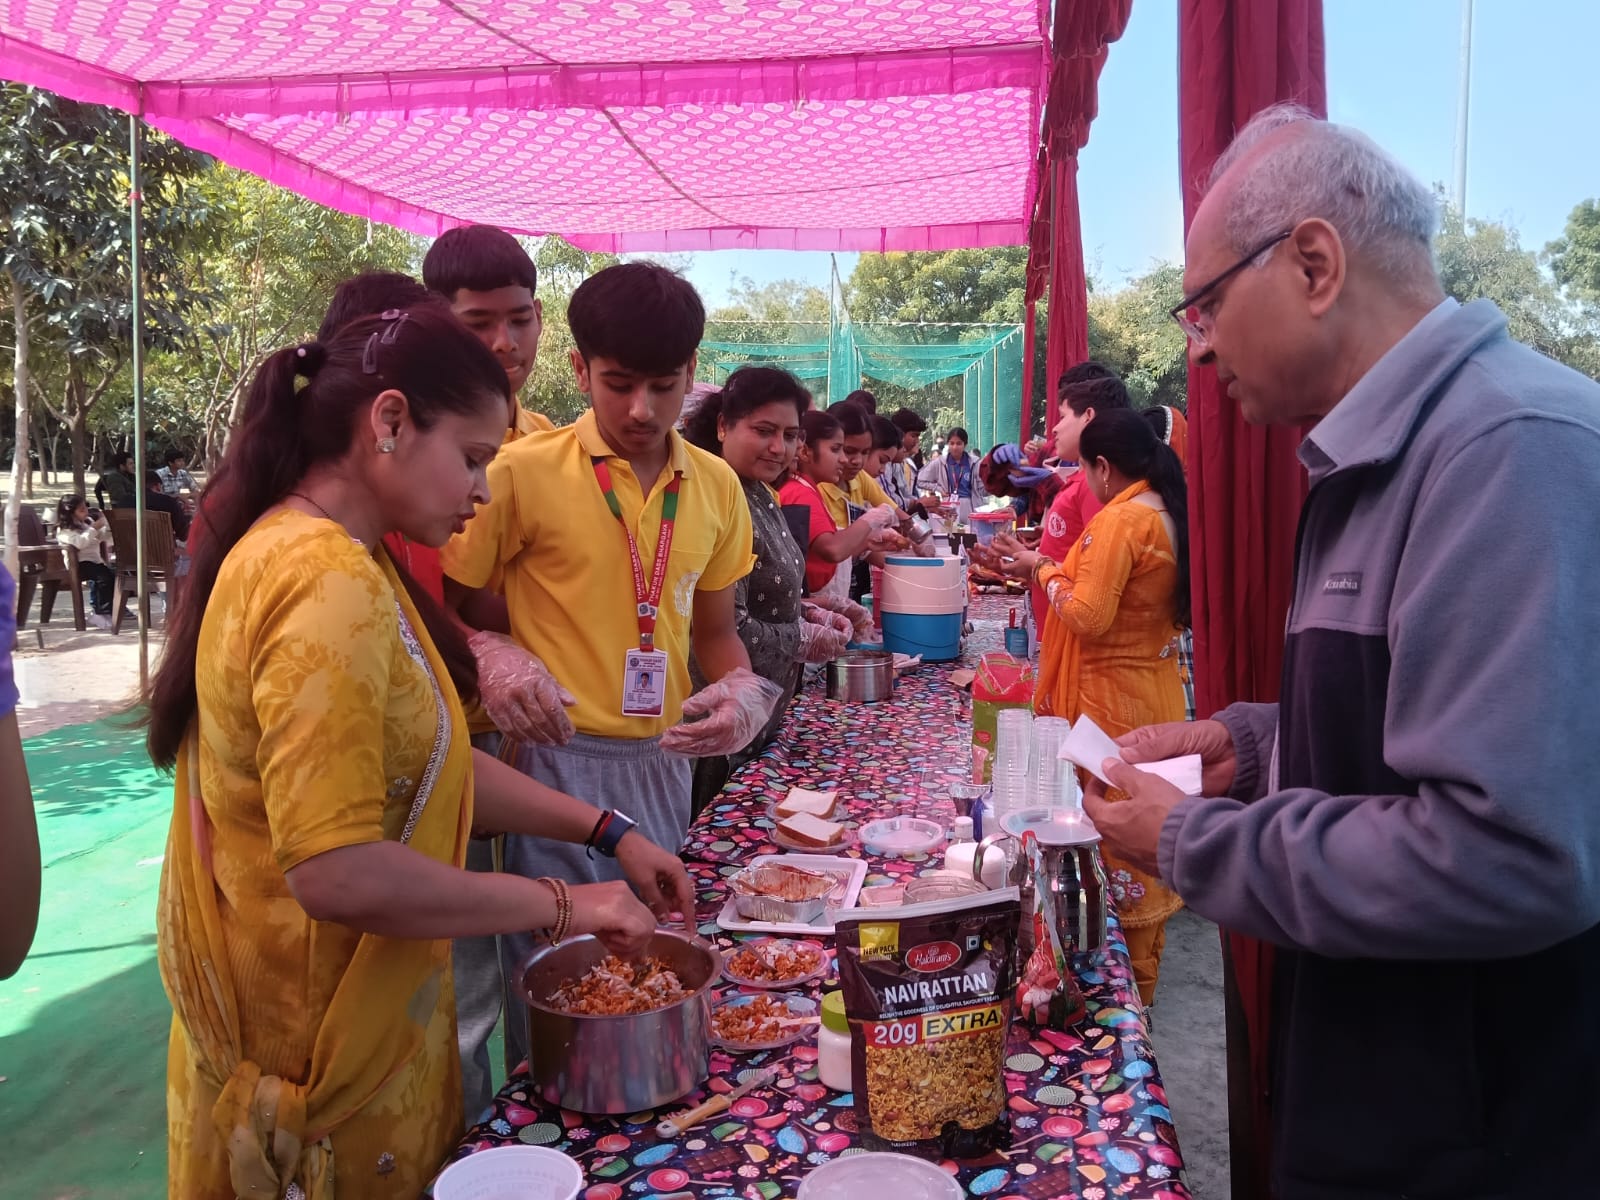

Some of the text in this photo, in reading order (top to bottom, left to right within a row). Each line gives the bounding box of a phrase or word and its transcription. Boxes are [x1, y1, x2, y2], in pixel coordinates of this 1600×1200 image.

[648, 576, 658, 602] THAKUR
[654, 558, 662, 576] DASS
[863, 944, 895, 956] NEW PACK
[914, 951, 952, 966] Haldiram's
[884, 972, 988, 1005] NAVRATTAN
[903, 1006, 928, 1016] GOODNESS
[935, 1000, 963, 1010] DELIGHTFUL
[874, 1008, 999, 1045] 20g EXTRA
